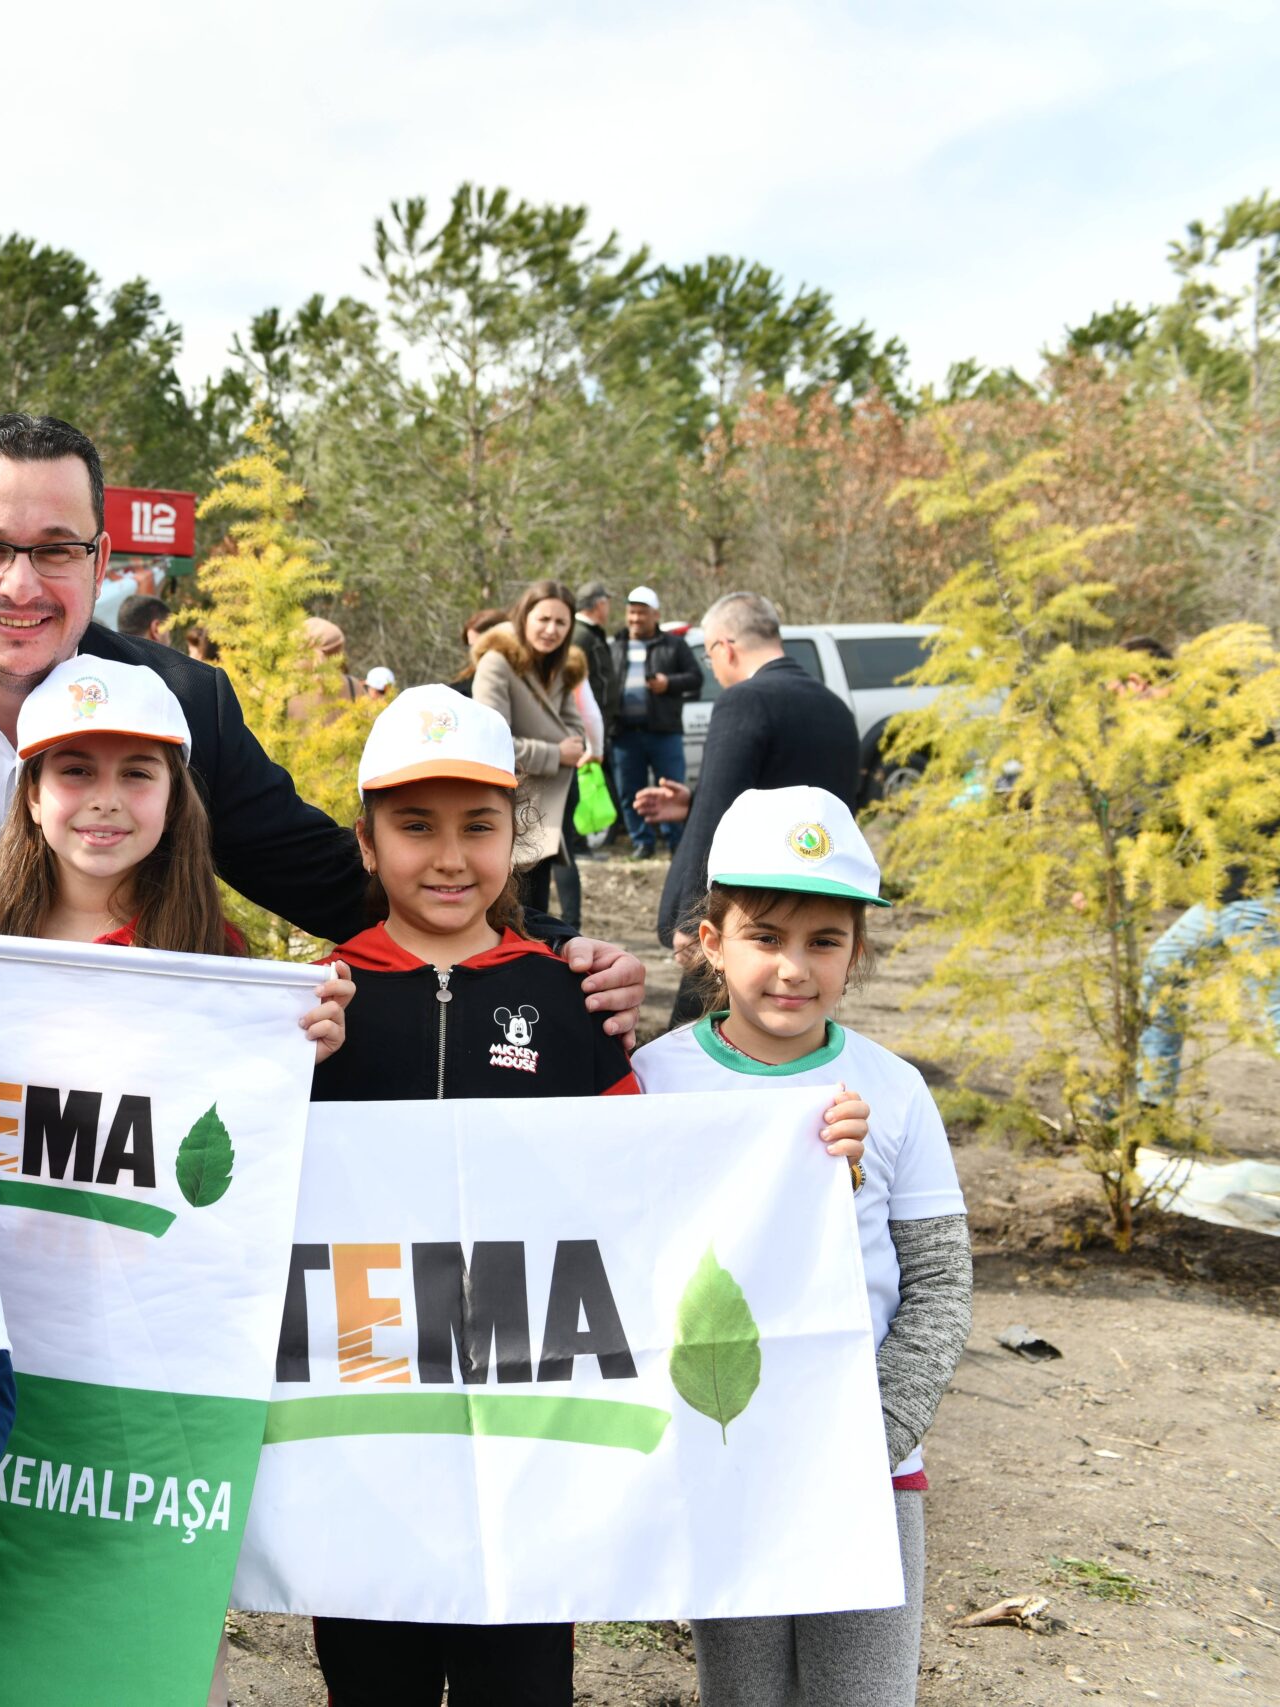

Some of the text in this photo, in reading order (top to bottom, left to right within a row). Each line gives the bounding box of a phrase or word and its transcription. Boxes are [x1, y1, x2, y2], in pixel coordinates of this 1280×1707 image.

[132, 501, 176, 535] 112
[489, 1043, 539, 1061] MICKEY
[489, 1054, 537, 1073] MOUSE
[275, 1239, 639, 1385] TEMA
